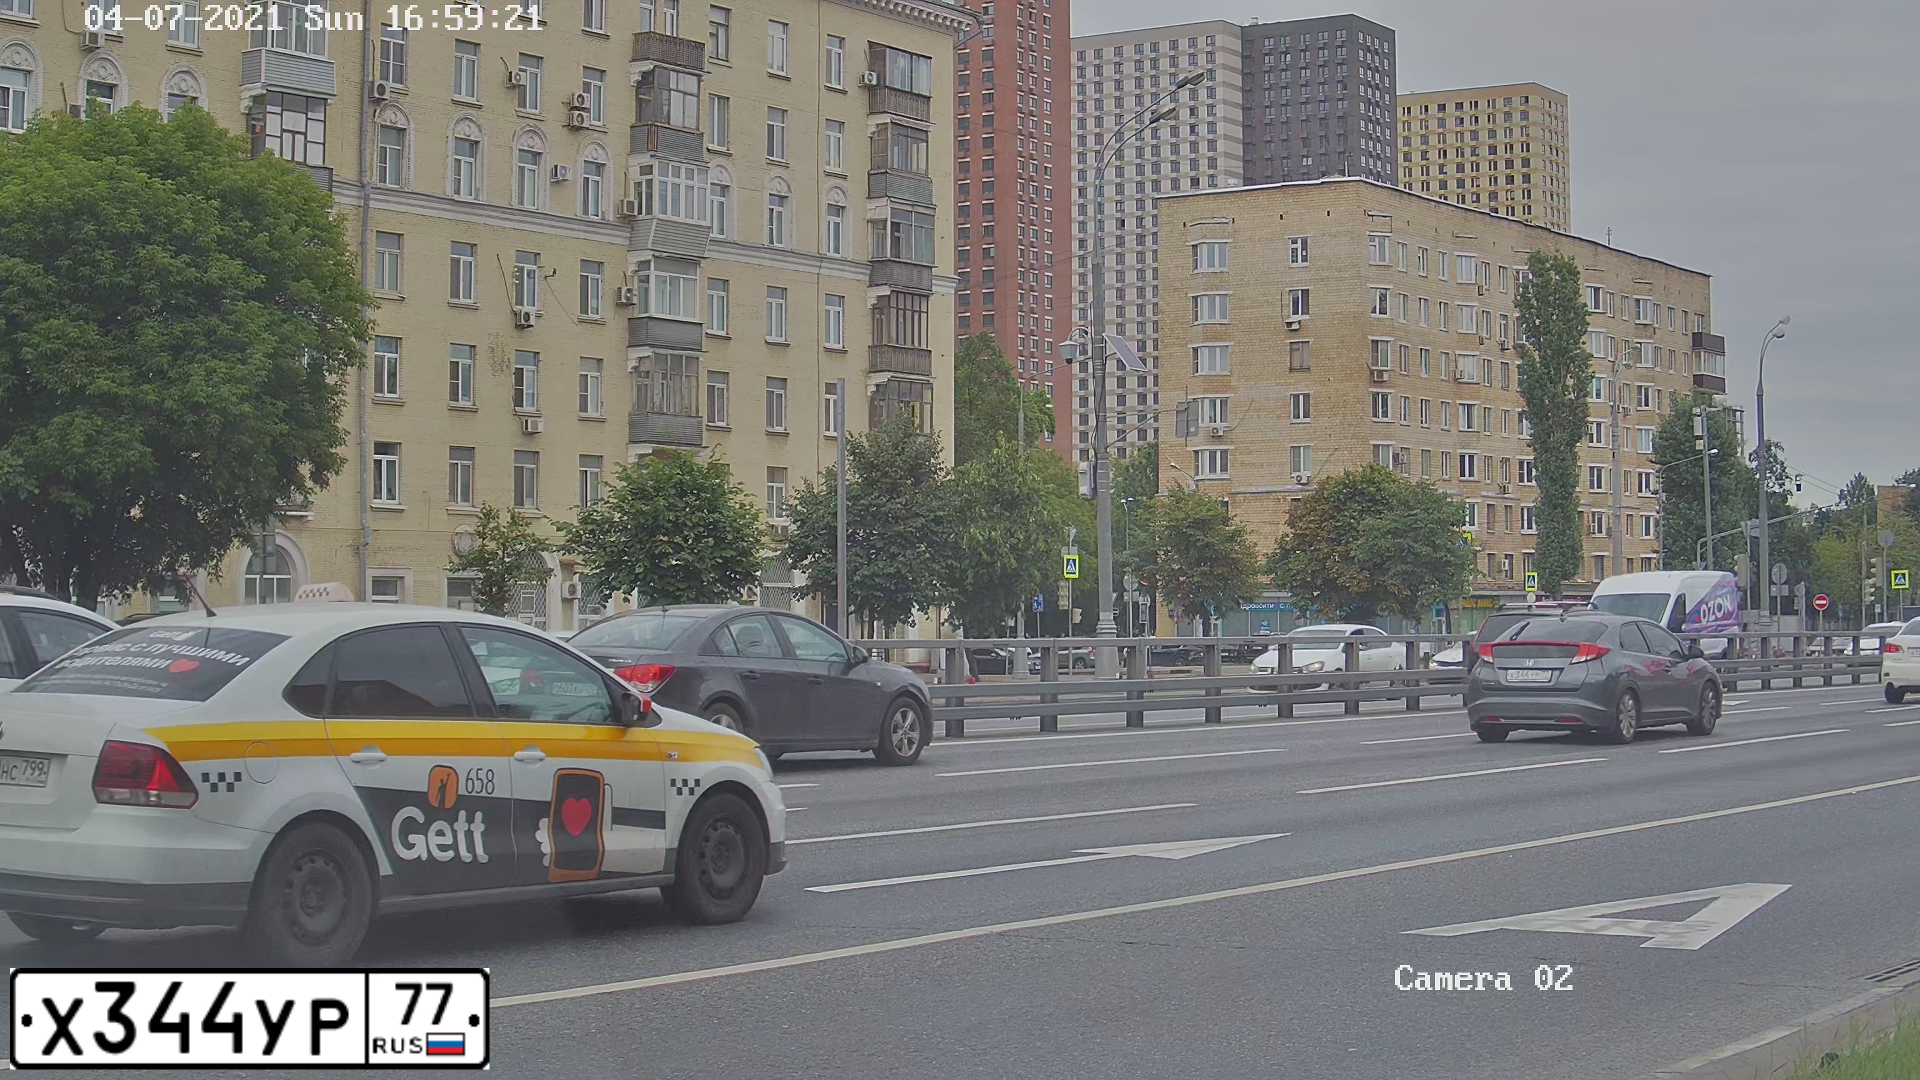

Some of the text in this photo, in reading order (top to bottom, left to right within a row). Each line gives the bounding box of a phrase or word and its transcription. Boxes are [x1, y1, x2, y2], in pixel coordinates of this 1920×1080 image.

[1700, 594, 1733, 624] OZON
[0, 759, 45, 781] НС 799
[465, 768, 495, 795] 658
[391, 806, 489, 863] Gett
